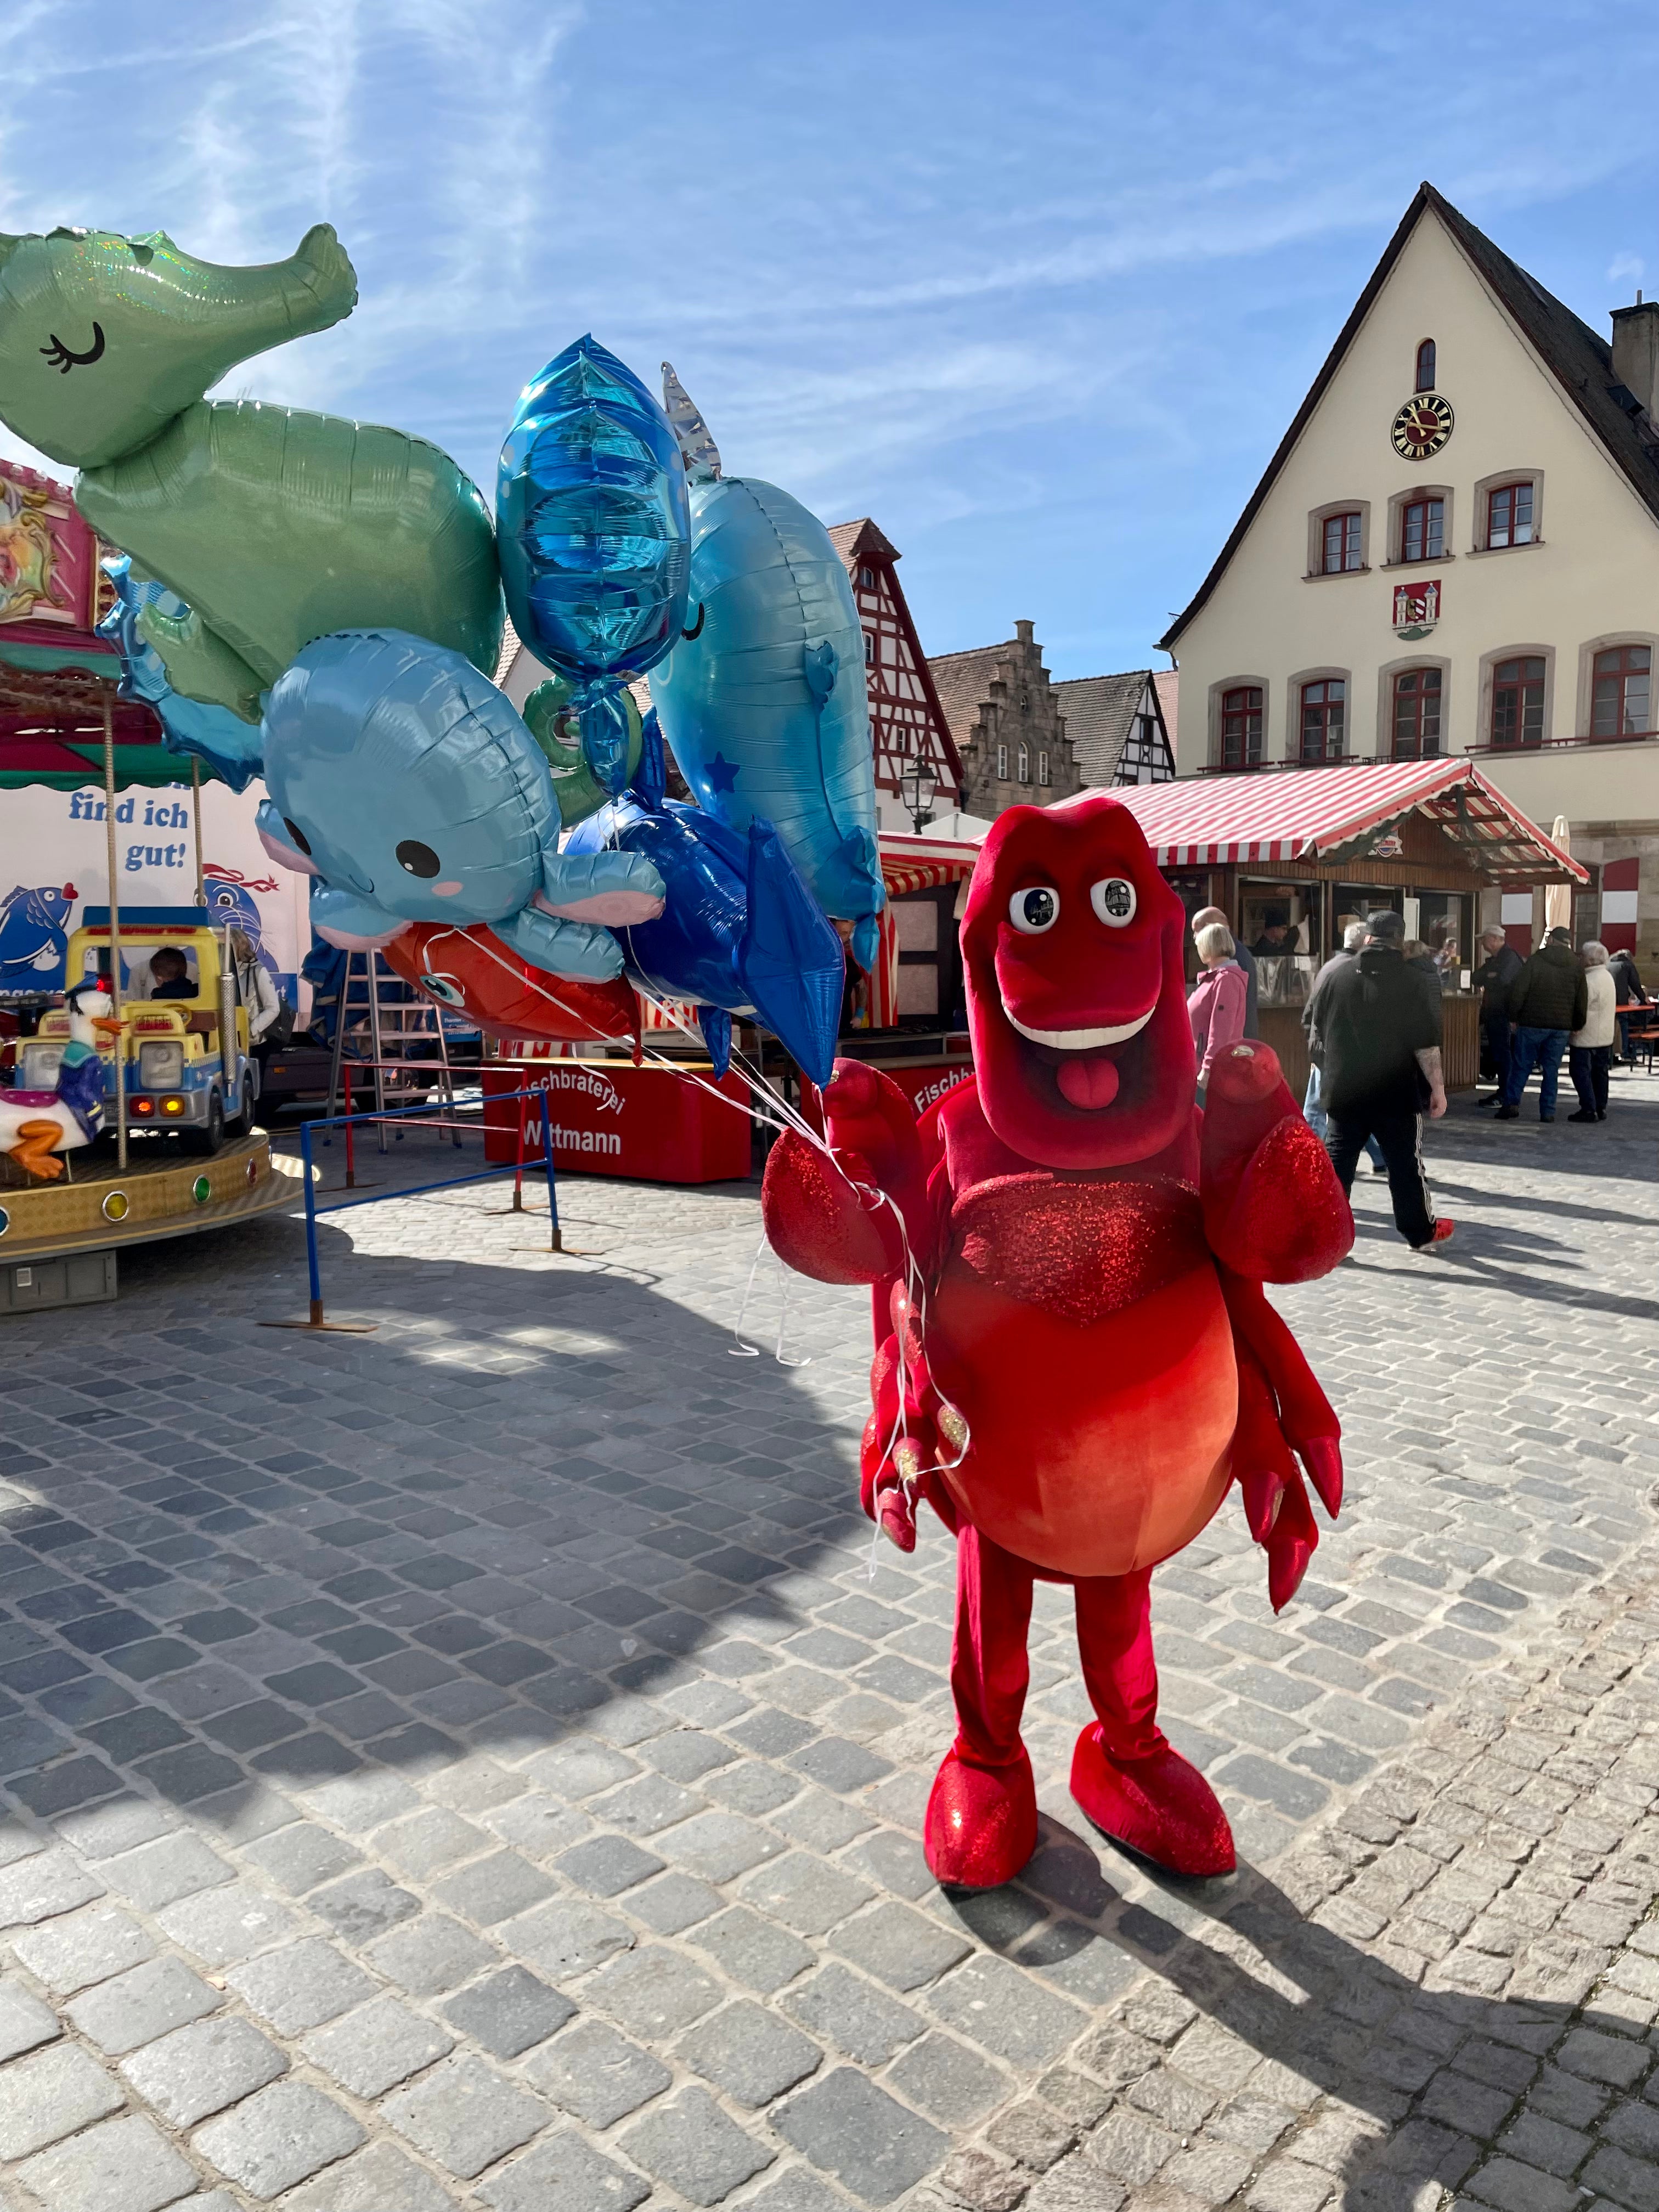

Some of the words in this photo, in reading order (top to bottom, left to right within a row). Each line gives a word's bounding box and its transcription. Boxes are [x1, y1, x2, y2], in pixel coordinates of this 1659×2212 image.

[69, 792, 135, 823] find
[143, 800, 188, 828] ich
[125, 843, 186, 871] gut!
[523, 1120, 621, 1155] Wttmann
